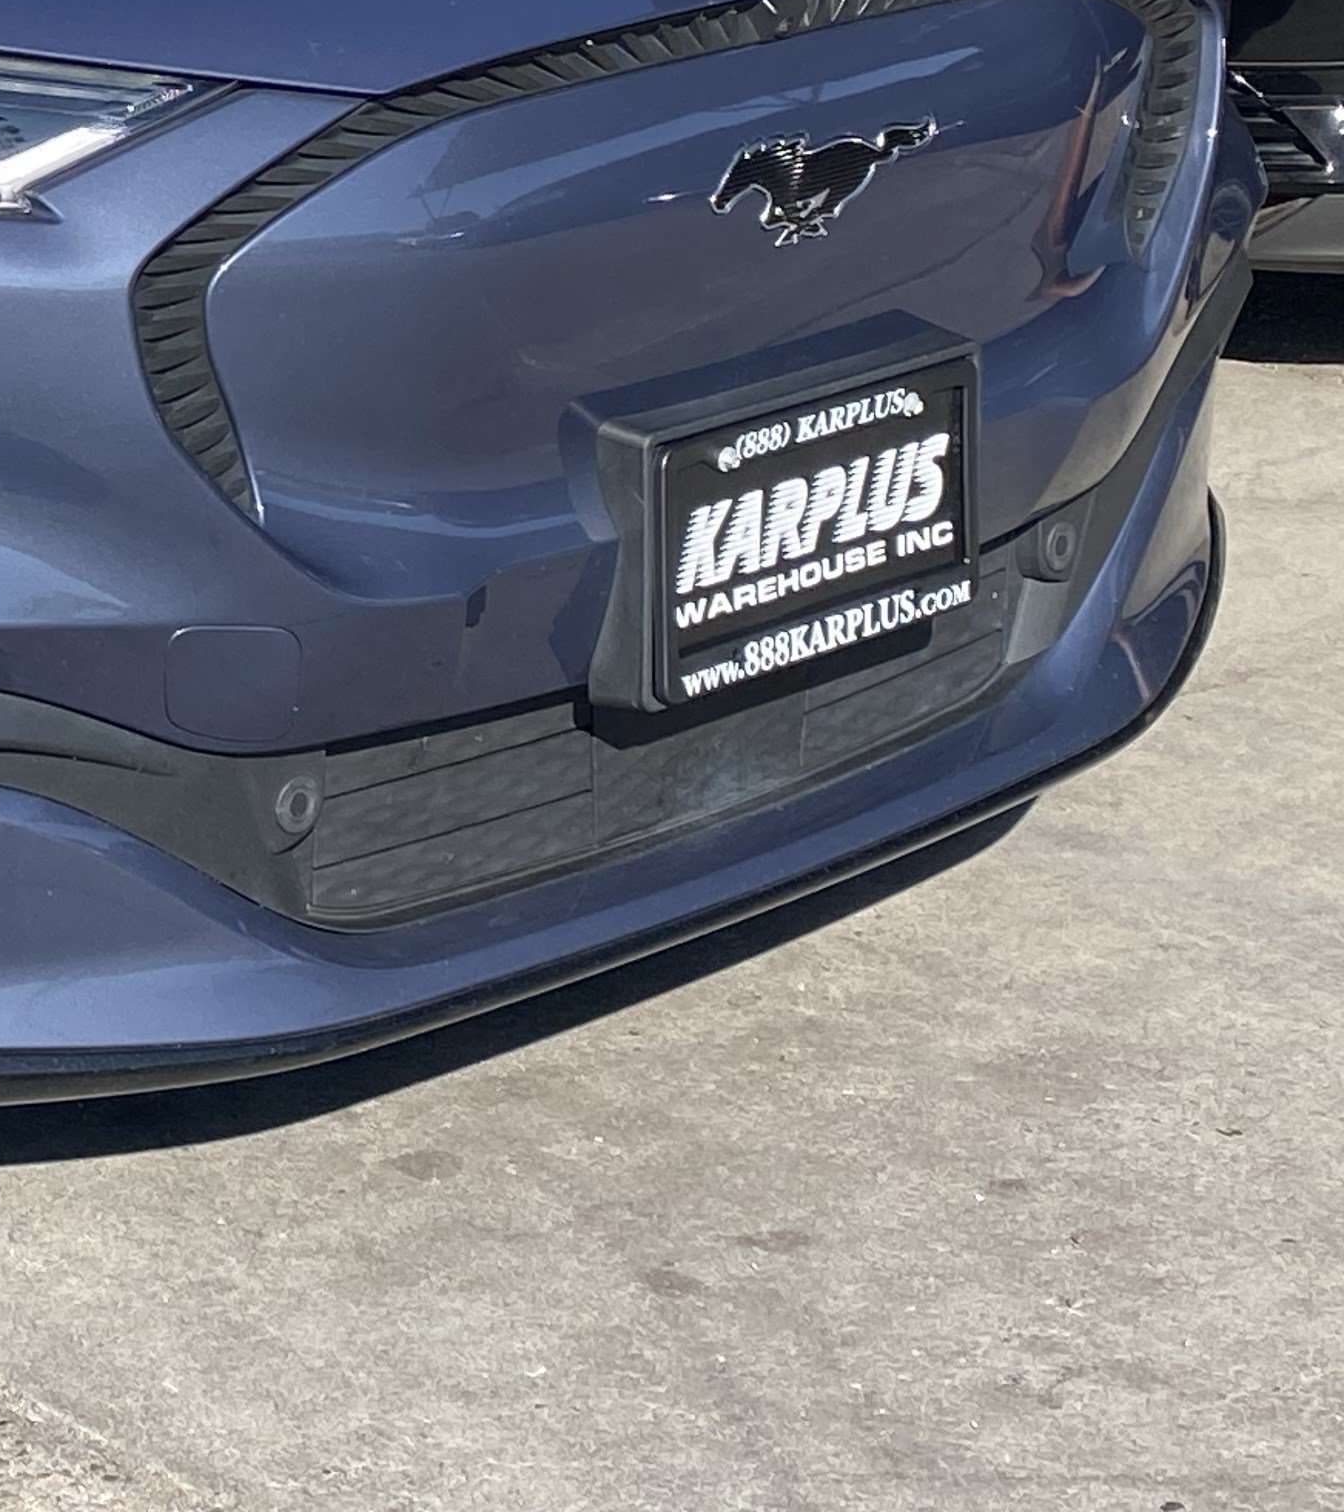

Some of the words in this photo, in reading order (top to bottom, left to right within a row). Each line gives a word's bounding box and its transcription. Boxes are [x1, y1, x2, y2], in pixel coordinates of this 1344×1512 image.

[735, 422, 791, 460] (888)
[796, 388, 907, 443] KARPLUS
[675, 433, 950, 595] KARPLUS
[675, 540, 887, 628] WAREHOUSE
[897, 521, 954, 557] INC
